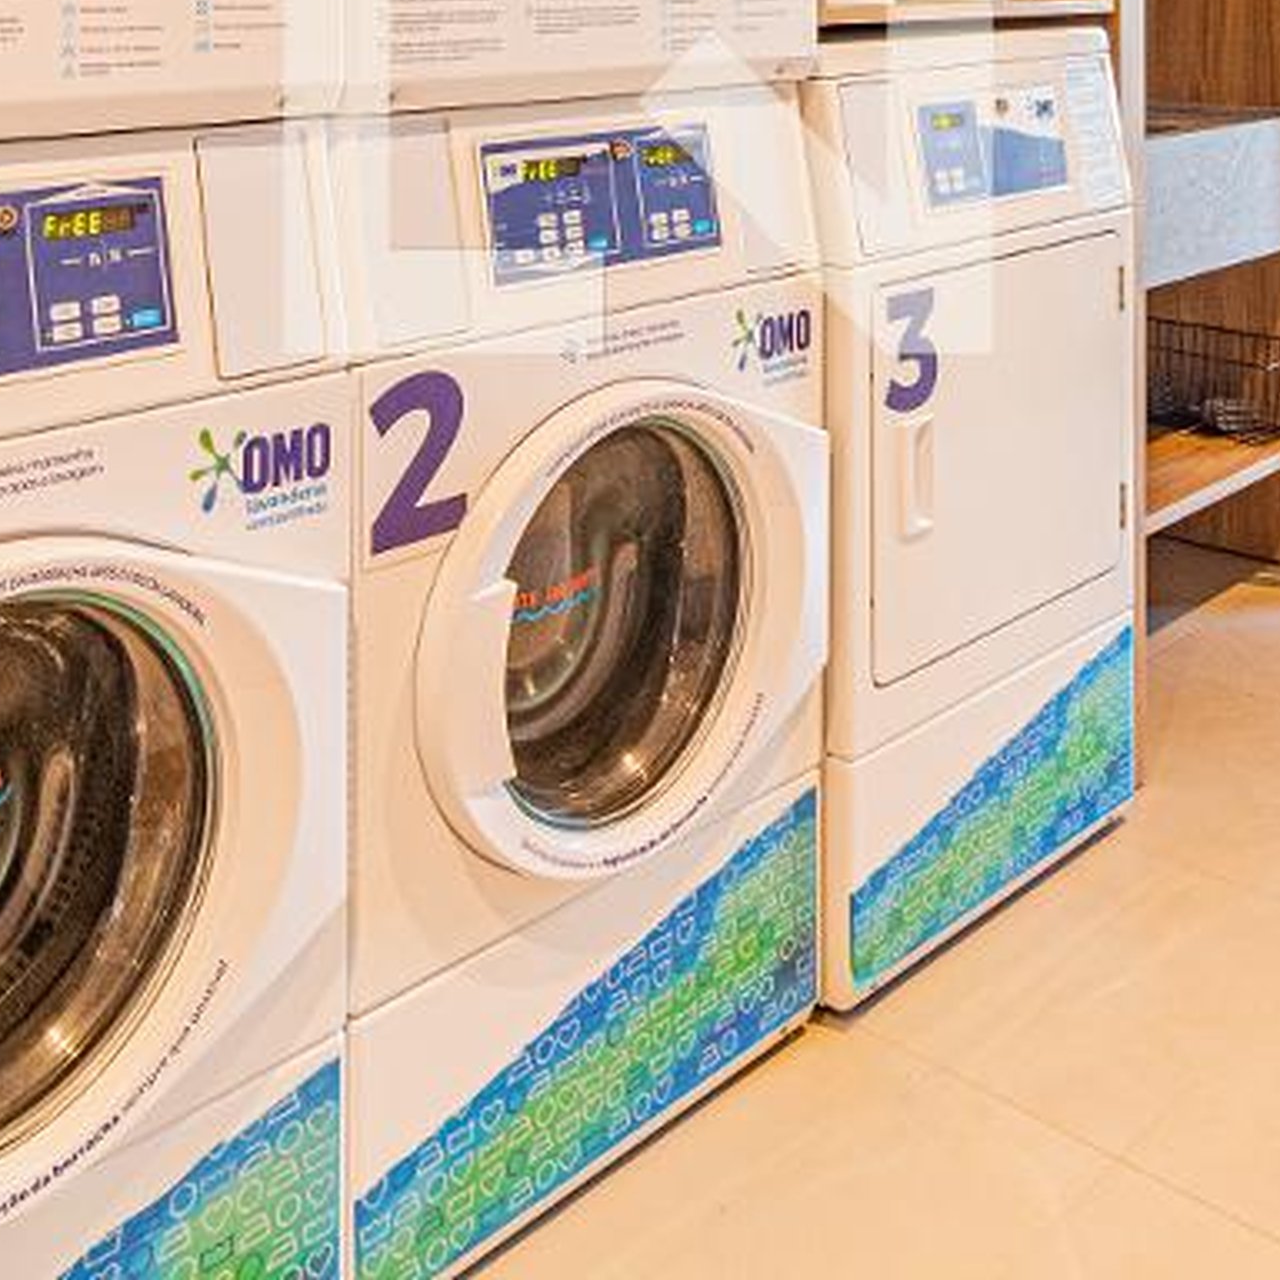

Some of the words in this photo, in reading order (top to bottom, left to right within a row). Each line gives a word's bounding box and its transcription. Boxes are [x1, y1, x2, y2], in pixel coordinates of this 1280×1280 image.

[758, 309, 812, 360] OMO
[884, 286, 940, 413] 3
[241, 422, 331, 495] OMO
[369, 370, 469, 556] 2
[52, 1114, 121, 1178] borracha
